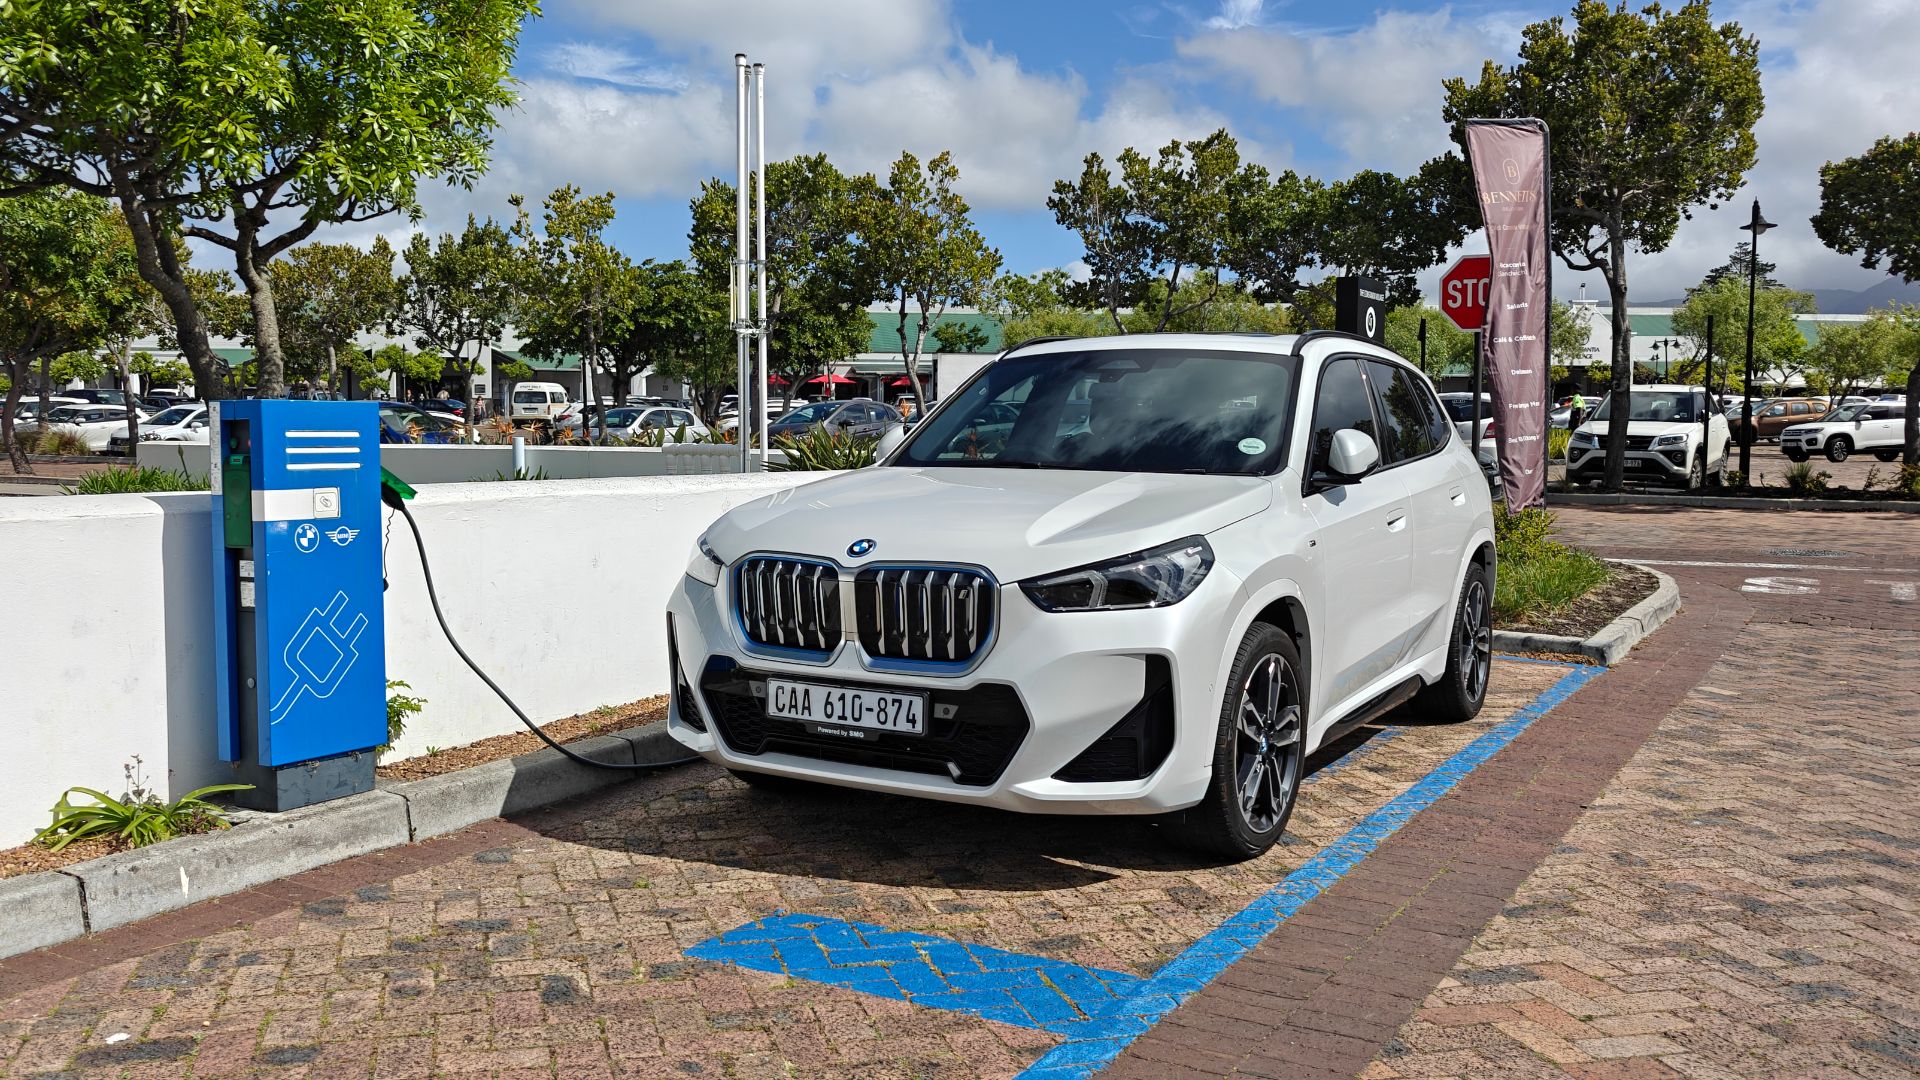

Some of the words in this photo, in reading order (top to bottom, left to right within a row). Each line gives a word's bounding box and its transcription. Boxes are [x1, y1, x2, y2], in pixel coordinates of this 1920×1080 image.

[1507, 166, 1517, 177] B
[1447, 278, 1489, 308] STO
[775, 685, 812, 717] CAA
[823, 691, 917, 729] 610-874
[817, 726, 839, 736] Powered
[840, 728, 848, 737] by
[849, 730, 865, 738] SMG
